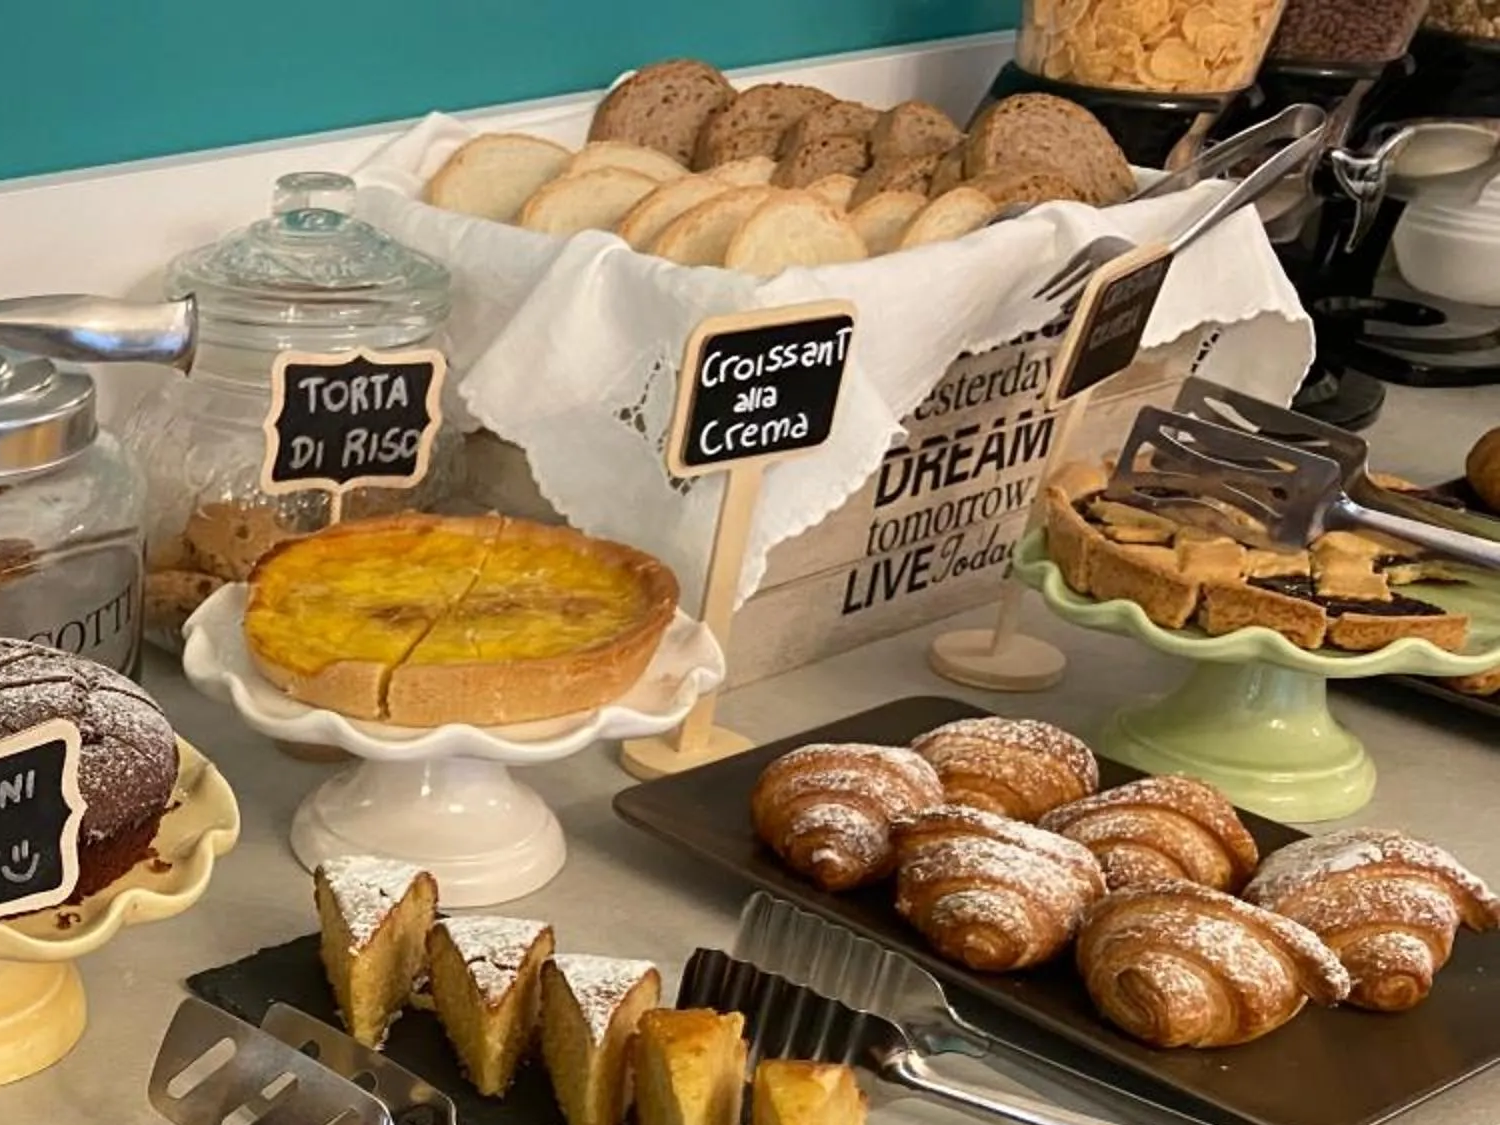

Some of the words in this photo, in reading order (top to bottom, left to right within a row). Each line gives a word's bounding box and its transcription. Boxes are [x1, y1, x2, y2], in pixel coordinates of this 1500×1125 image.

[298, 374, 408, 416] TORTA
[733, 386, 777, 413] alla
[900, 350, 1054, 424] esterday
[289, 436, 324, 469] DI
[341, 427, 422, 469] RISO
[700, 413, 808, 455] Crema
[873, 410, 1056, 508] DREAM
[841, 545, 935, 616] LIVE
